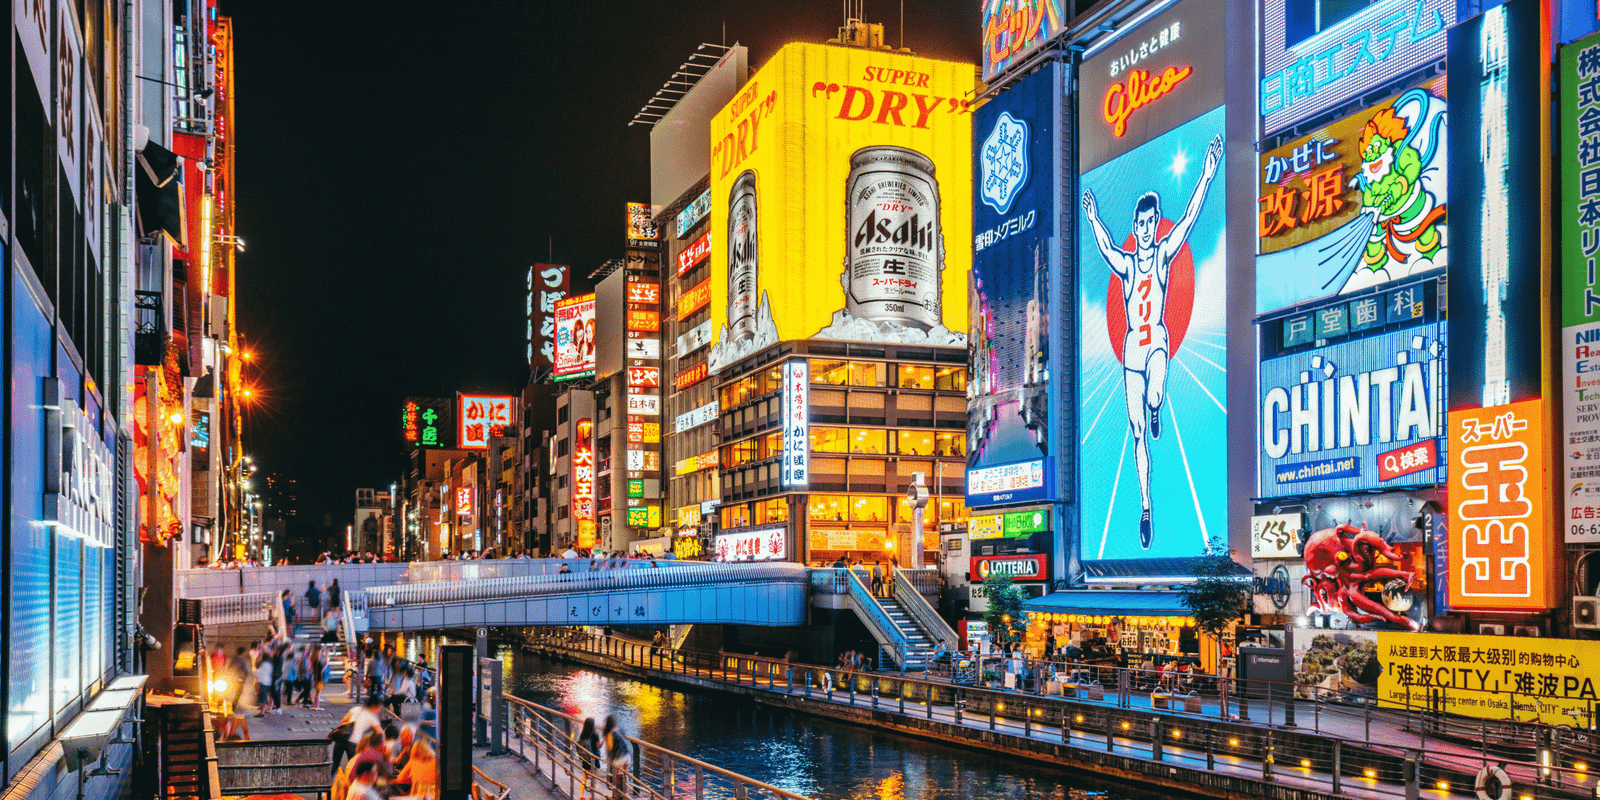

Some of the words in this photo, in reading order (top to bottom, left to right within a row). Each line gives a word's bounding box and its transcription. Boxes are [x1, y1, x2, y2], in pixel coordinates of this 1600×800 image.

[1110, 21, 1180, 77] おいしさと健康
[1261, 0, 1445, 115] 日商エステム
[863, 65, 930, 88] SUPER
[730, 81, 758, 123] SUPER
[1104, 66, 1192, 138] Glico
[1264, 138, 1338, 184] かぜに
[1258, 164, 1344, 237] 改源
[855, 209, 932, 252] Asahi
[975, 210, 1035, 251] 雪印メグミルク
[872, 278, 917, 289] スーパードライ
[883, 259, 906, 275] 生
[885, 303, 905, 312] 350ml
[1137, 274, 1153, 347] グリコ
[1289, 288, 1415, 341] 戸堂歯科
[466, 401, 506, 421] かに
[629, 398, 656, 409] 白木屋
[1263, 357, 1442, 459] CHINTAI
[1461, 412, 1527, 443] スーパー
[1400, 447, 1429, 470] 検索
[1458, 442, 1532, 597] 玉出
[990, 560, 1034, 575] LOTTERIA
[570, 606, 646, 617] えびす橋
[1458, 696, 1478, 706] center
[1479, 696, 1486, 707] in
